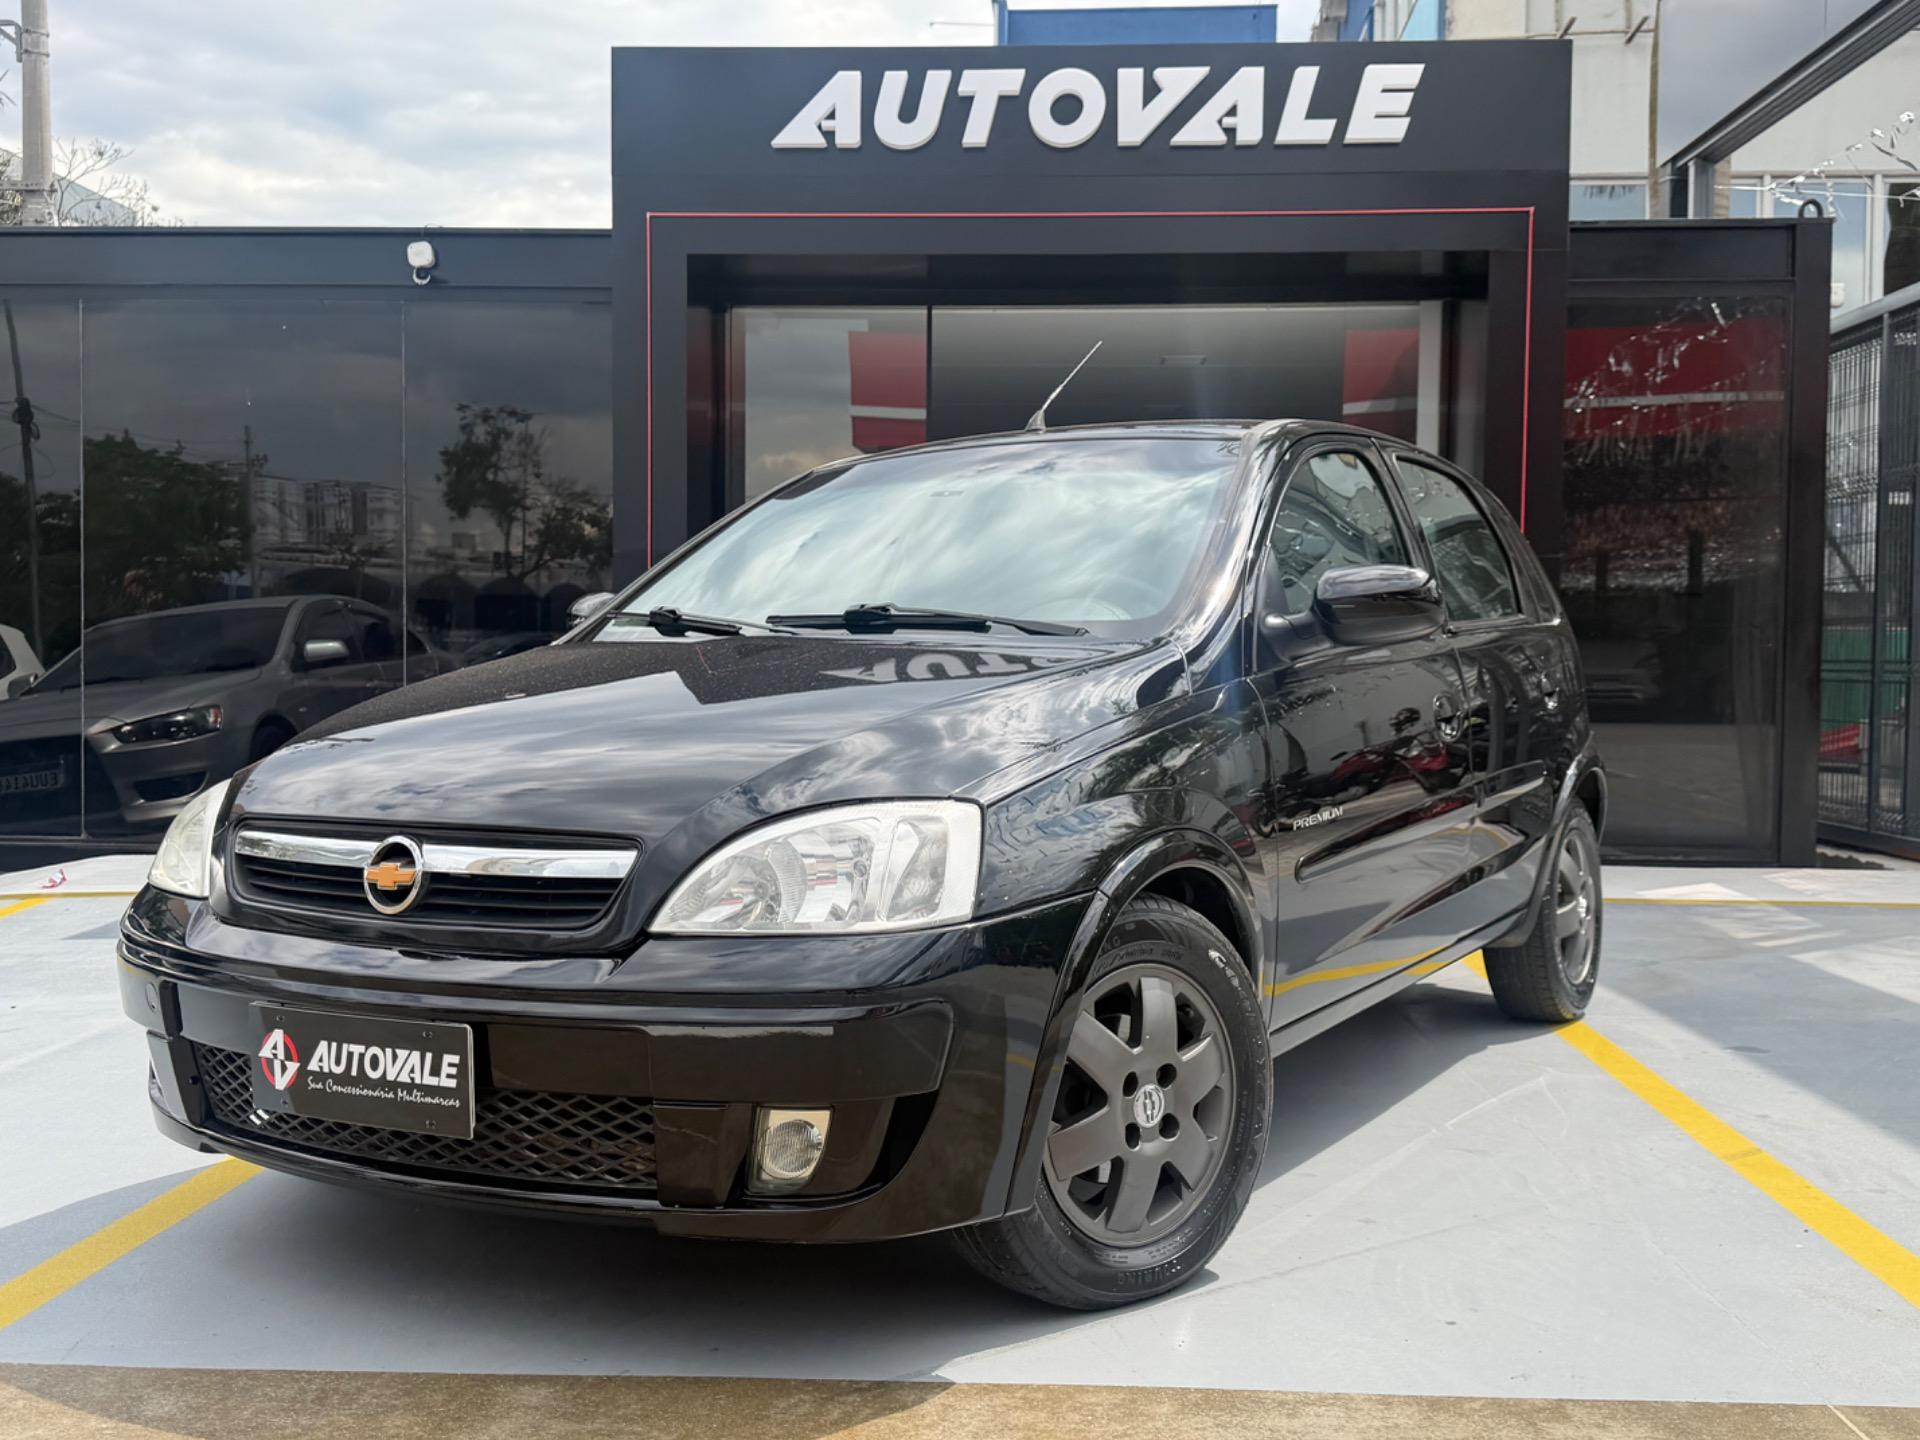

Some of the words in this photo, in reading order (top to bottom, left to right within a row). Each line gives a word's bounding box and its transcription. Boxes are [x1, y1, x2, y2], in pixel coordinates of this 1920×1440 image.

[771, 63, 1426, 149] AUTOVALE
[1293, 806, 1343, 831] PREMIUM
[307, 1040, 460, 1088] AUTOVALE
[307, 1076, 324, 1090] Sua
[397, 1088, 461, 1108] Multimarcas
